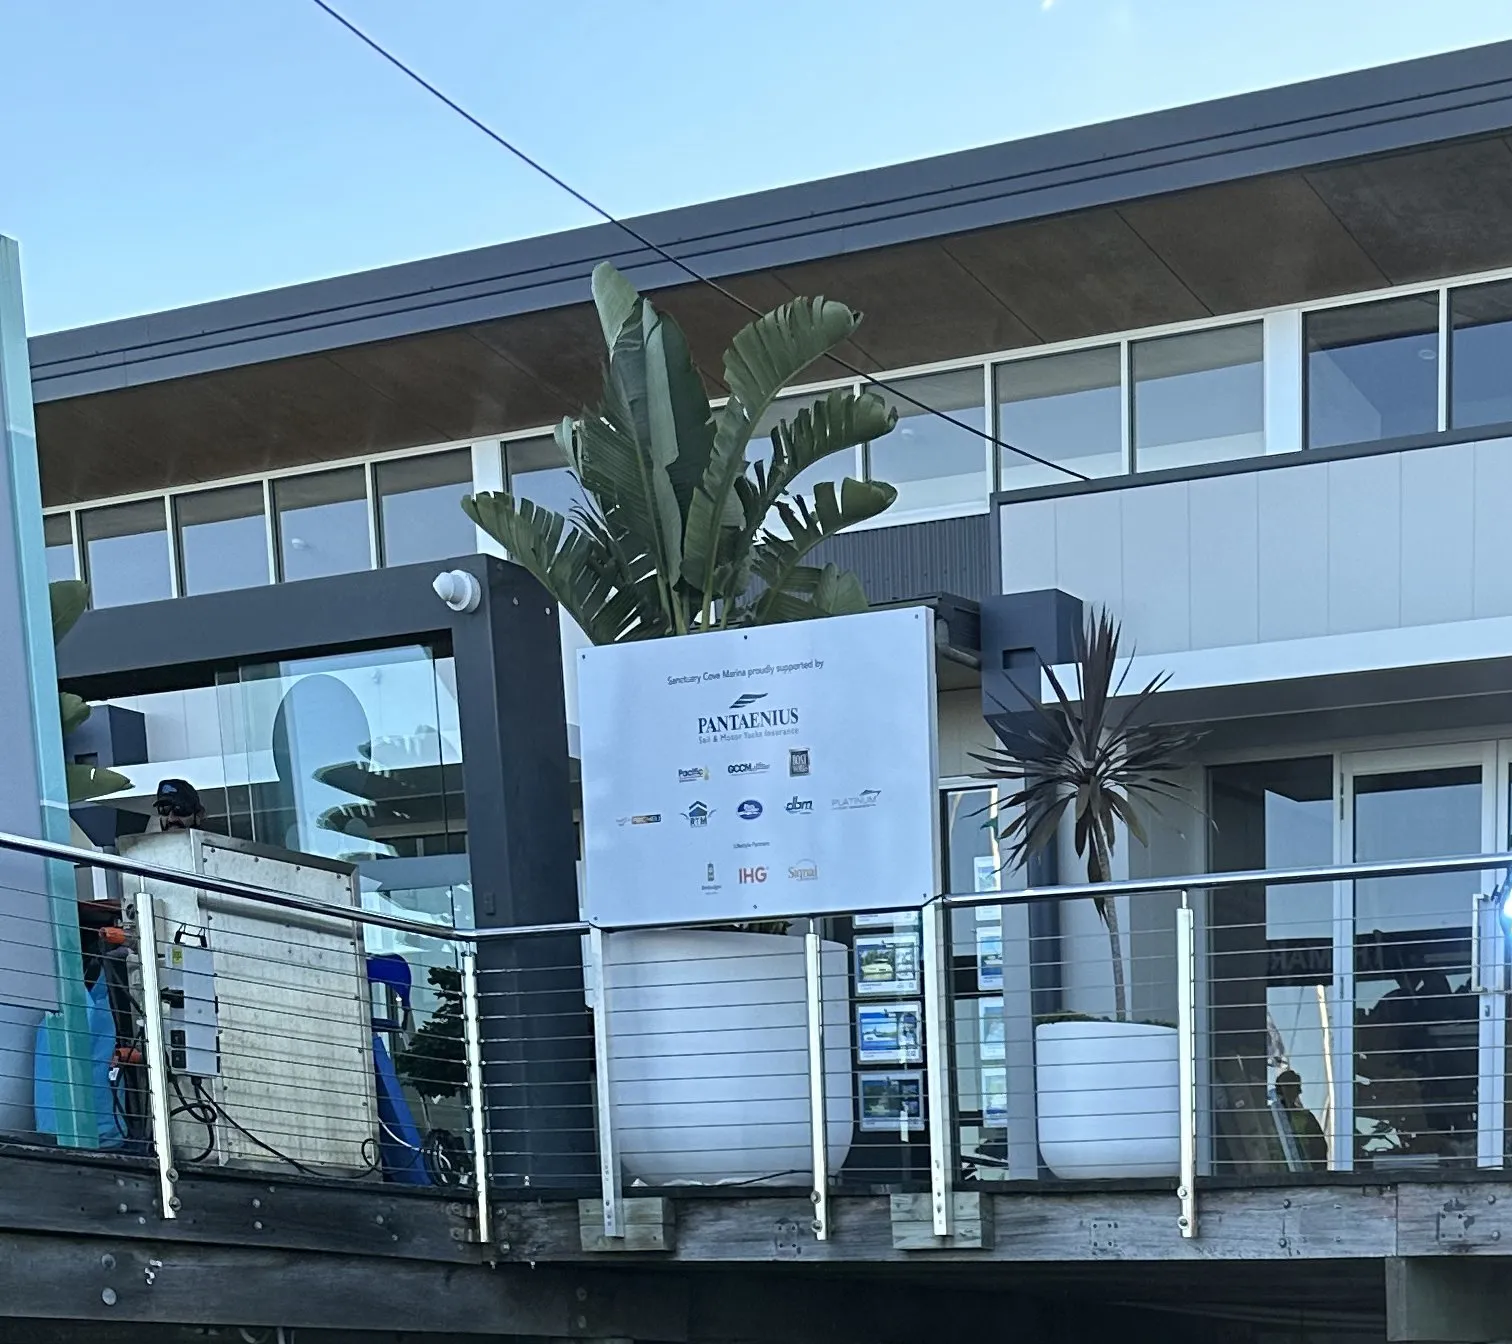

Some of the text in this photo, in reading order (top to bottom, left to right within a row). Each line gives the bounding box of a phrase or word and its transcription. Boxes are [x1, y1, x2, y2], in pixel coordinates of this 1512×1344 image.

[702, 671, 721, 682] Cove
[722, 668, 747, 679] Marina
[747, 664, 775, 678] proudly
[776, 660, 814, 673] supported
[814, 658, 824, 670] by
[697, 707, 800, 735] PANTAENIUS
[738, 866, 768, 884] IHG
